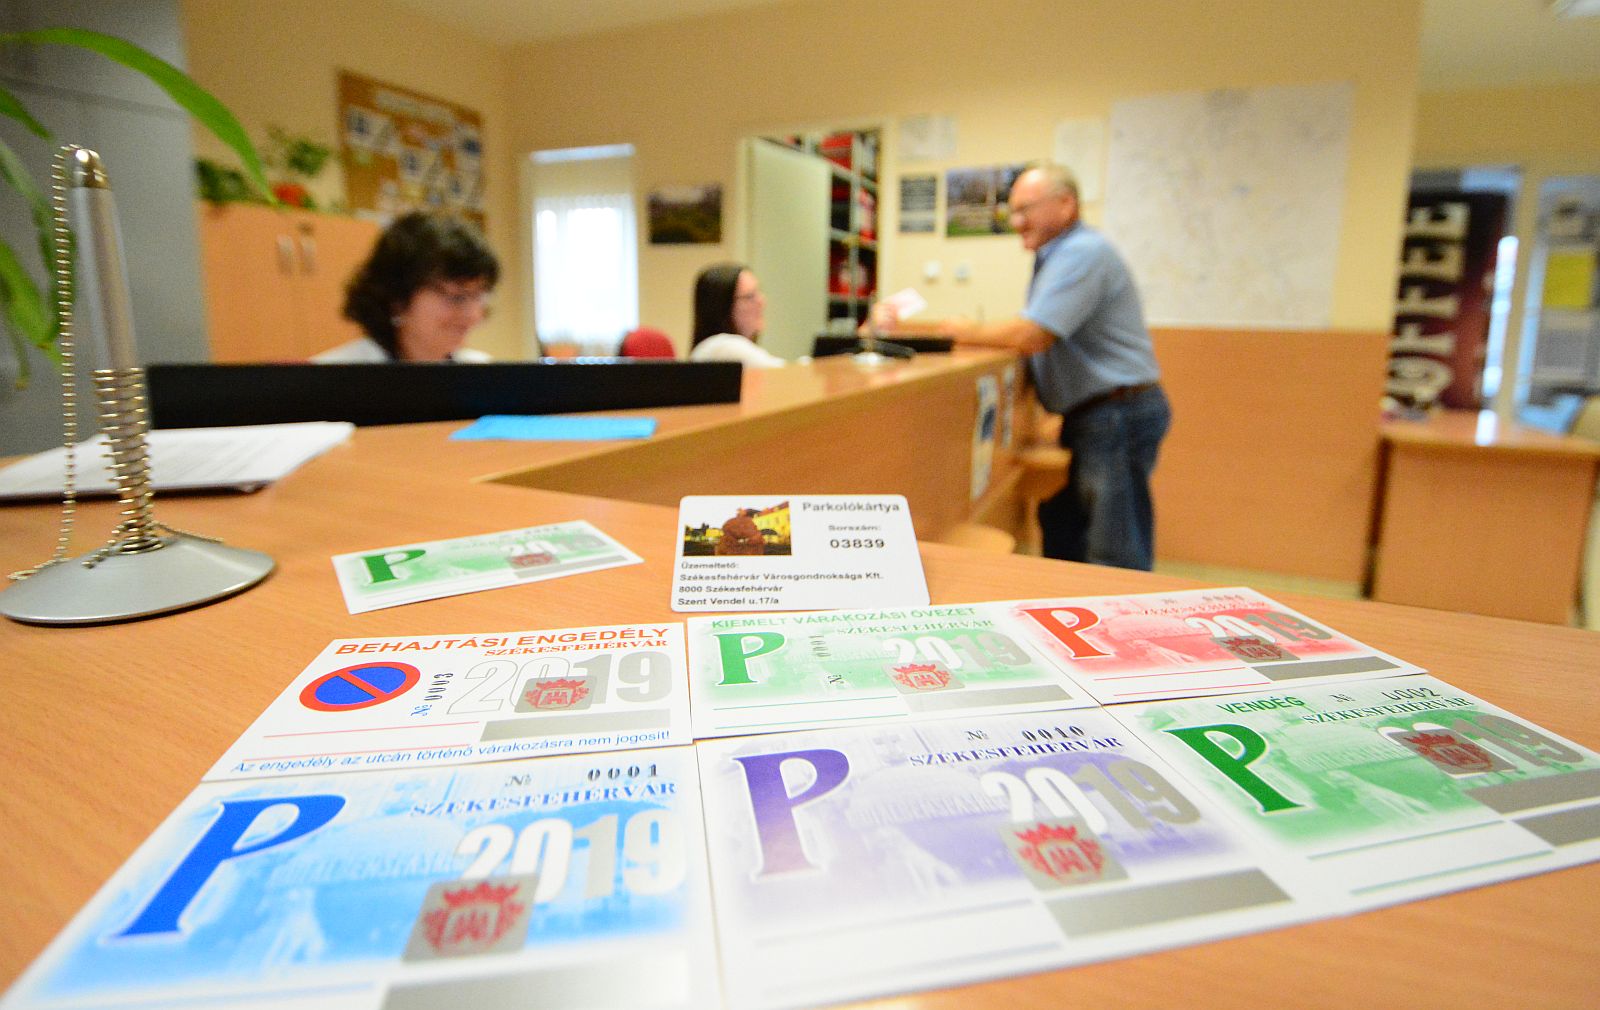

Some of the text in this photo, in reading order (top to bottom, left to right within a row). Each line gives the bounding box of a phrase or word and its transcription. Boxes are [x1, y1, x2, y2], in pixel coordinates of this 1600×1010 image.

[1384, 202, 1470, 406] OFFEE
[802, 501, 900, 513] Parkolókártya
[830, 538, 885, 549] 03839
[680, 573, 760, 581] Székesfehérvár
[763, 572, 863, 581] Városgondnoksága
[678, 585, 783, 593] 8000 Székesfehérvár
[678, 597, 707, 606] Szent
[710, 597, 746, 605] Vendel
[712, 617, 786, 629] KIEMELT
[1023, 606, 1112, 659] P
[335, 628, 669, 655] BEHAJTÁSI ENGEDÉLY
[484, 638, 668, 657] SZÉKESFEHÉRVÁR
[715, 632, 785, 686] P
[1216, 696, 1305, 714] VENDÉG
[1302, 697, 1476, 725] SZÉKESFEHÉRVÁR
[1021, 724, 1086, 742] 0010
[259, 755, 337, 772] engedély
[340, 756, 362, 765] az
[366, 751, 412, 763] utcán
[478, 737, 574, 755] várakozásra
[578, 735, 612, 746] nem
[587, 763, 660, 782] 0001
[1162, 723, 1305, 814] P
[732, 748, 850, 882] P
[452, 807, 686, 905] 2019
